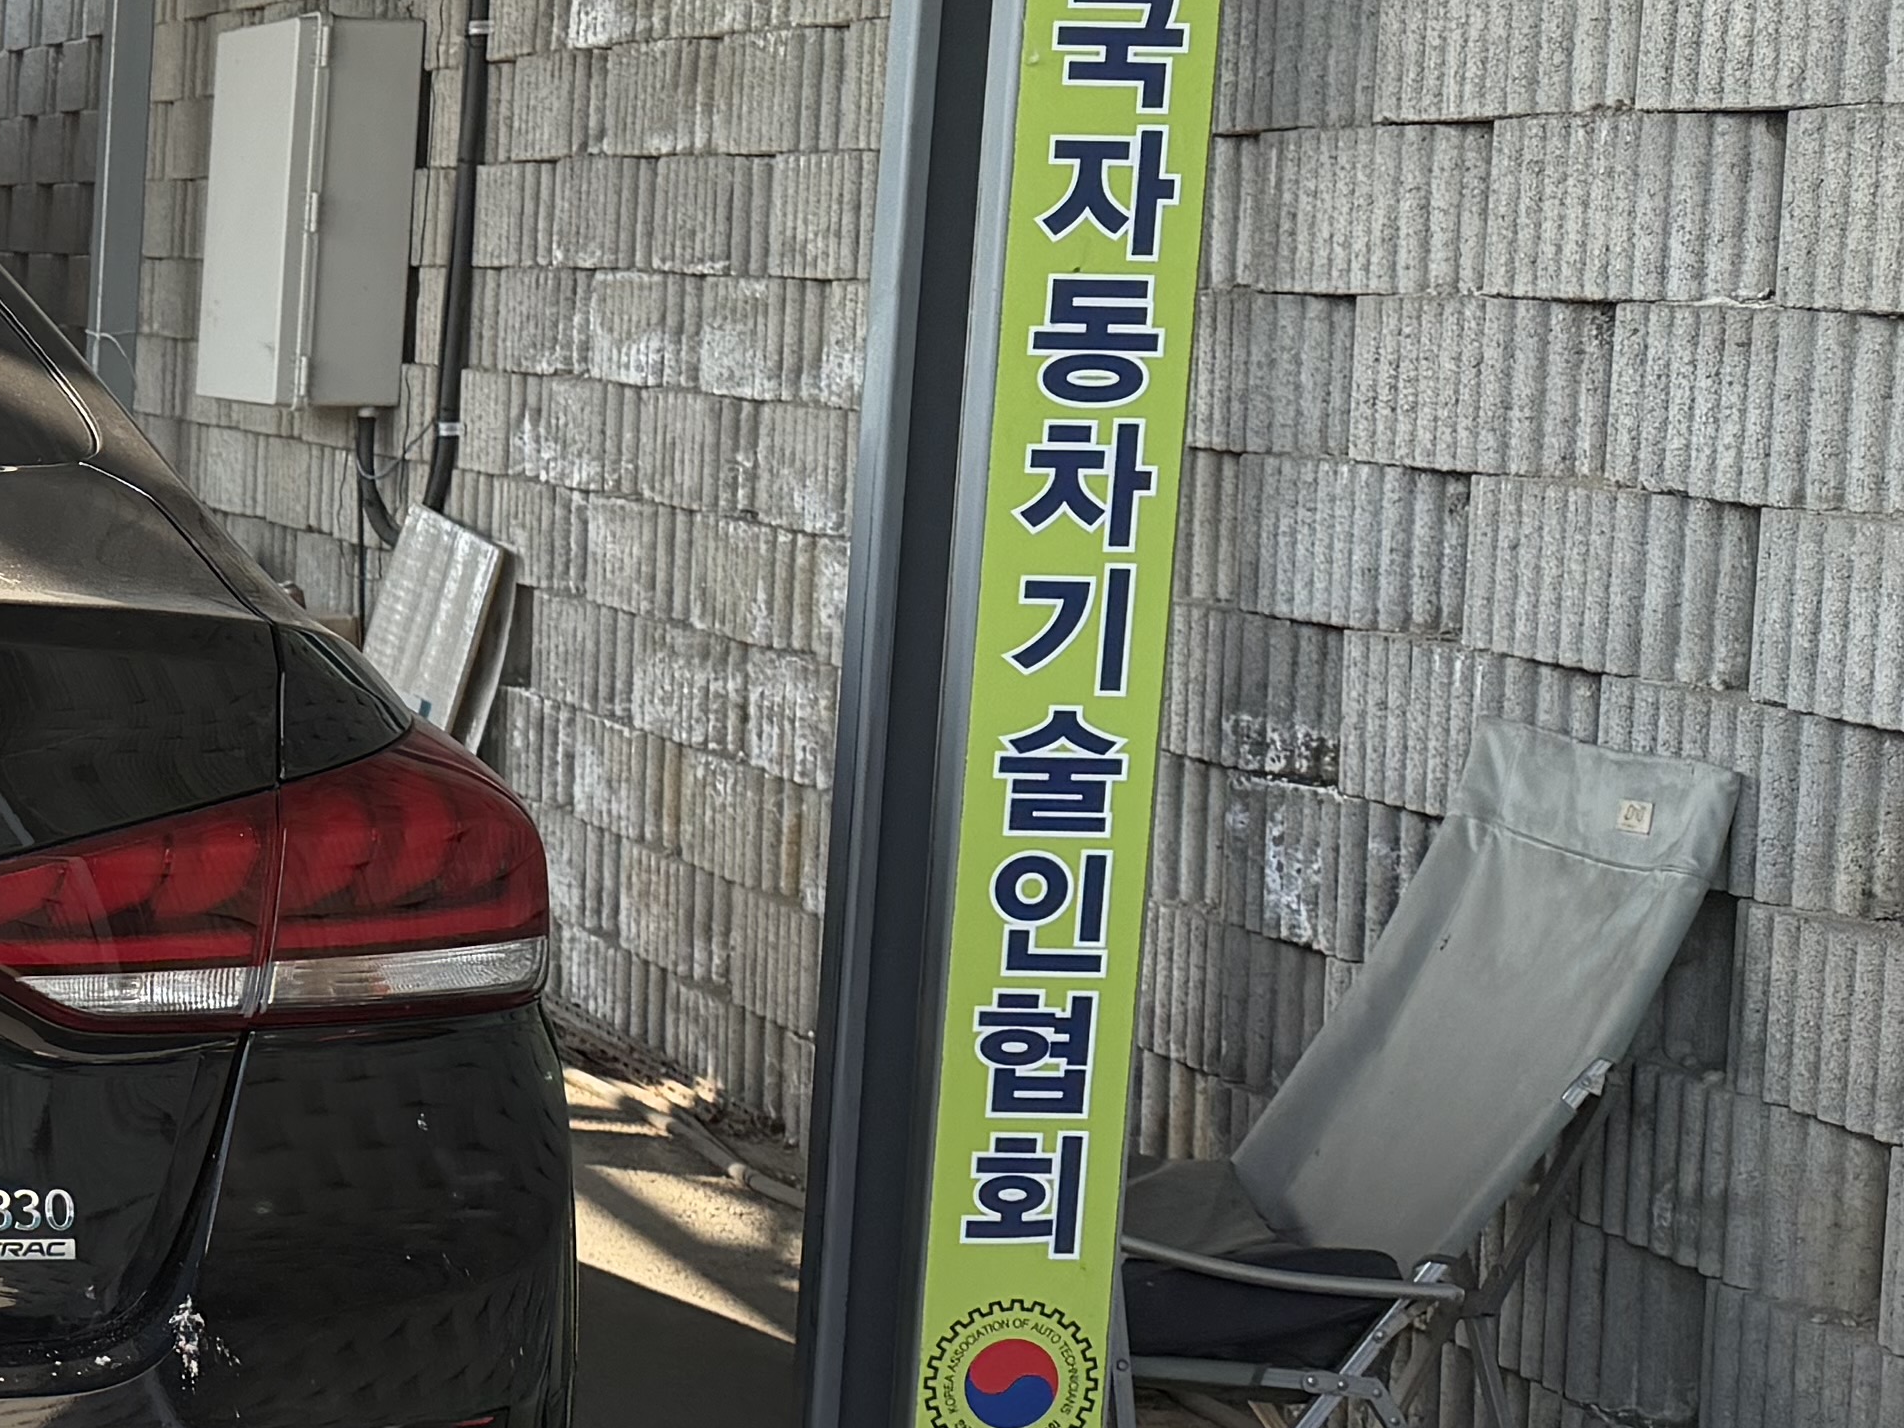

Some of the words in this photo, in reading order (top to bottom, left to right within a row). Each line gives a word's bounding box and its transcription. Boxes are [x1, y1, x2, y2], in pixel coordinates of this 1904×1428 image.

[1012, 1318, 1030, 1329] OF
[1031, 1322, 1062, 1345] AUTO
[950, 1318, 1009, 1372] ASSOCIATION
[943, 1374, 958, 1414] KOREA
